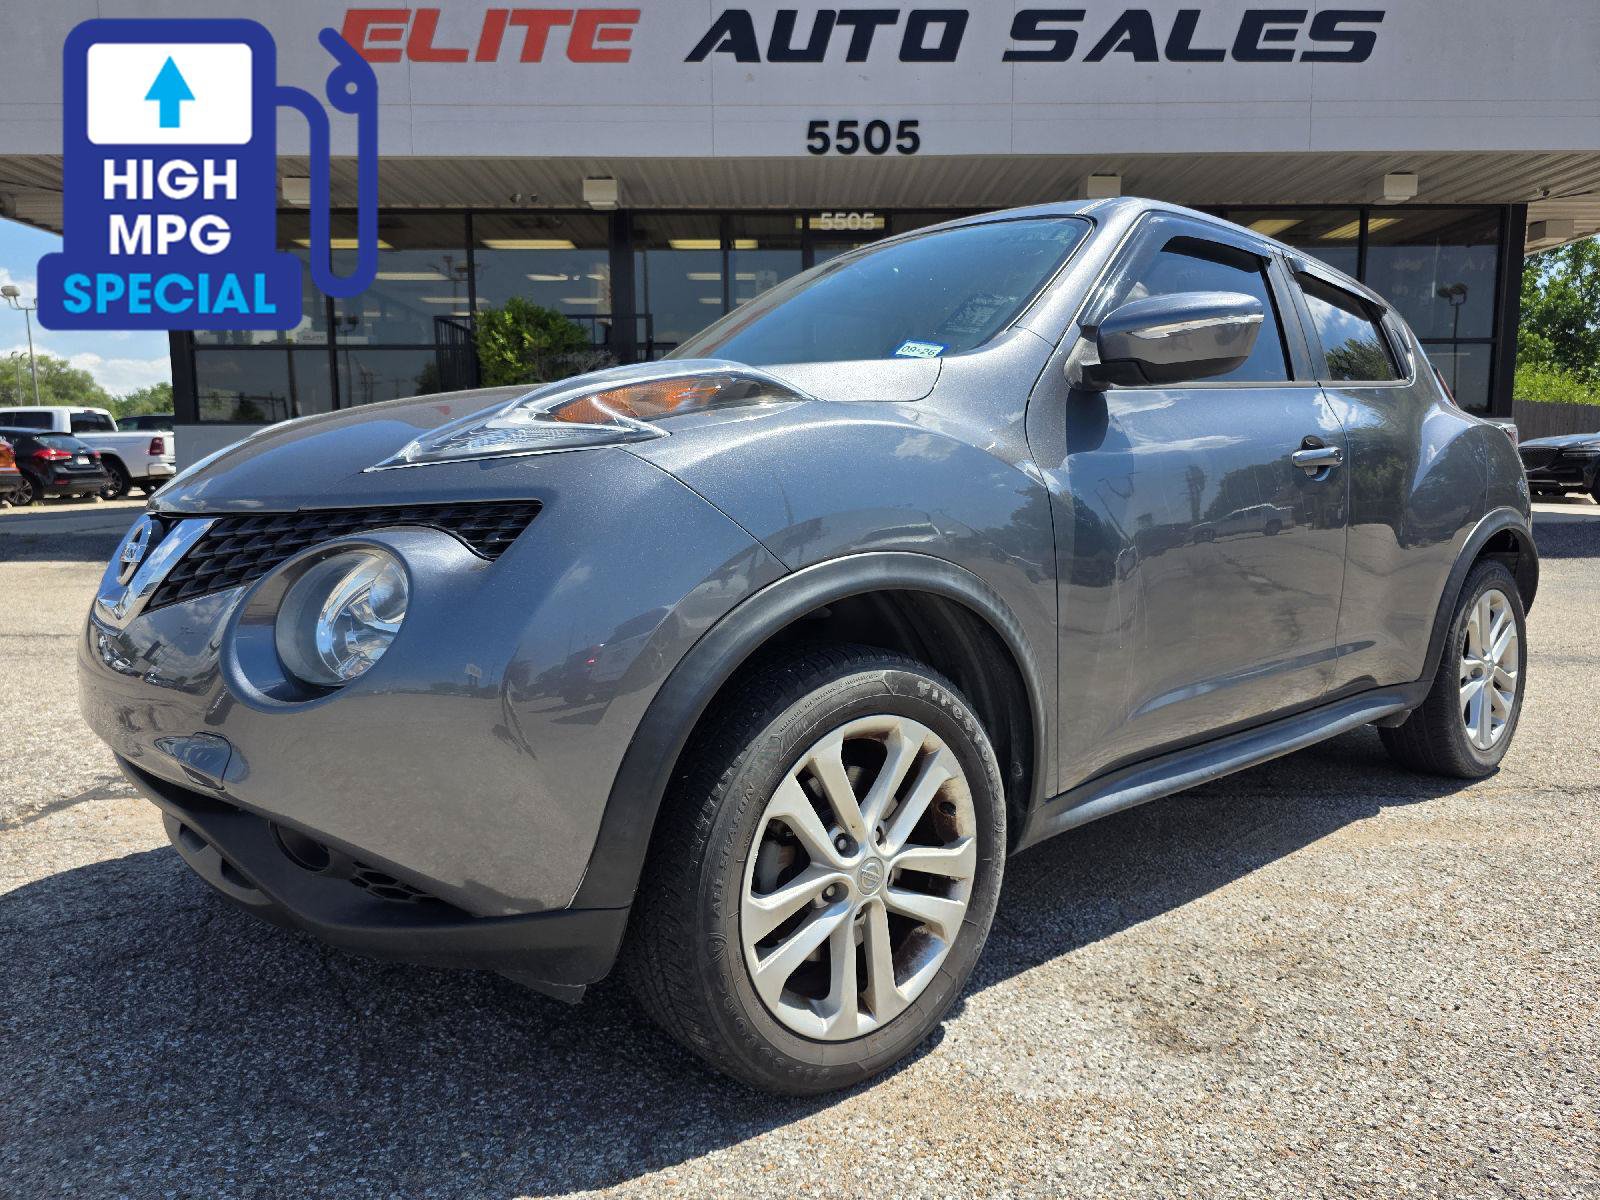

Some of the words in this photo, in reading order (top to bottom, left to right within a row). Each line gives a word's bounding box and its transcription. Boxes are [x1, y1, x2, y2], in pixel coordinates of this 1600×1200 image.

[341, 8, 641, 63] ELITE
[684, 9, 970, 63] AUTO
[1002, 9, 1385, 63] SALES
[807, 119, 921, 156] 5505
[821, 212, 875, 231] 5505
